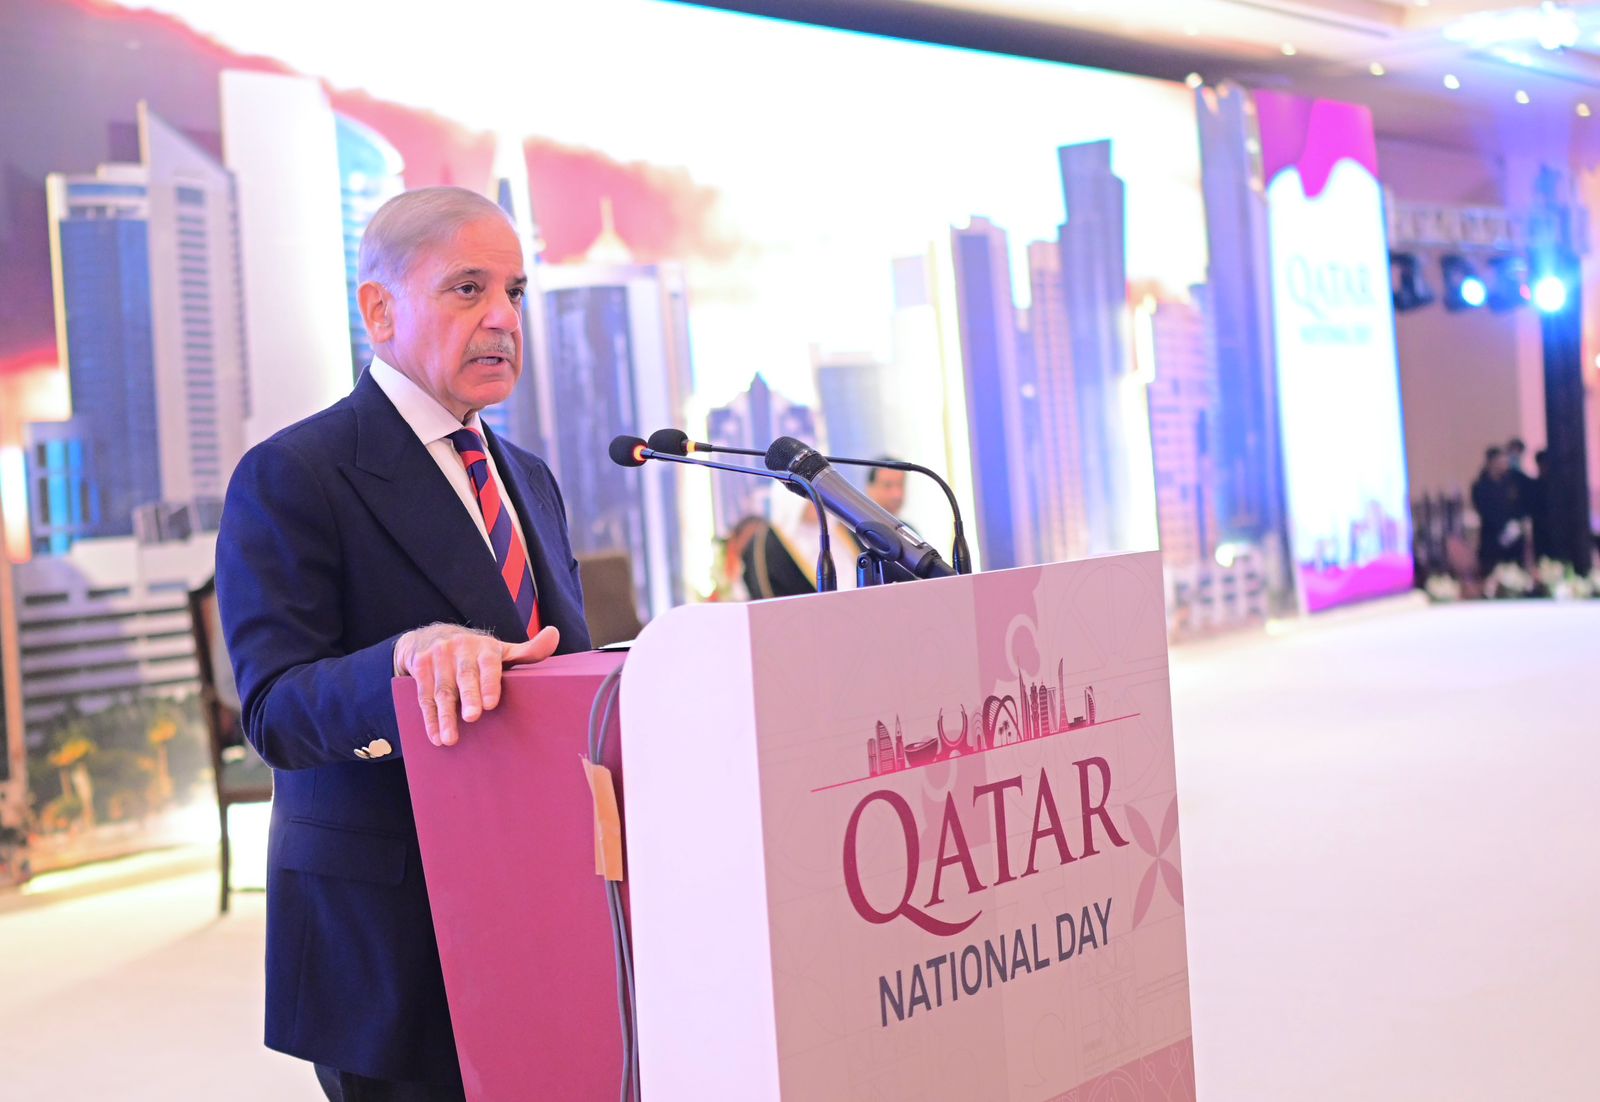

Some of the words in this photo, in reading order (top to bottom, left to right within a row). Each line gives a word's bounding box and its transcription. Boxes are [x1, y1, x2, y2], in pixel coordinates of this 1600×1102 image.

[843, 756, 1130, 937] QATAR
[879, 924, 1050, 1027] NATIONAL
[1055, 897, 1112, 962] DAY
